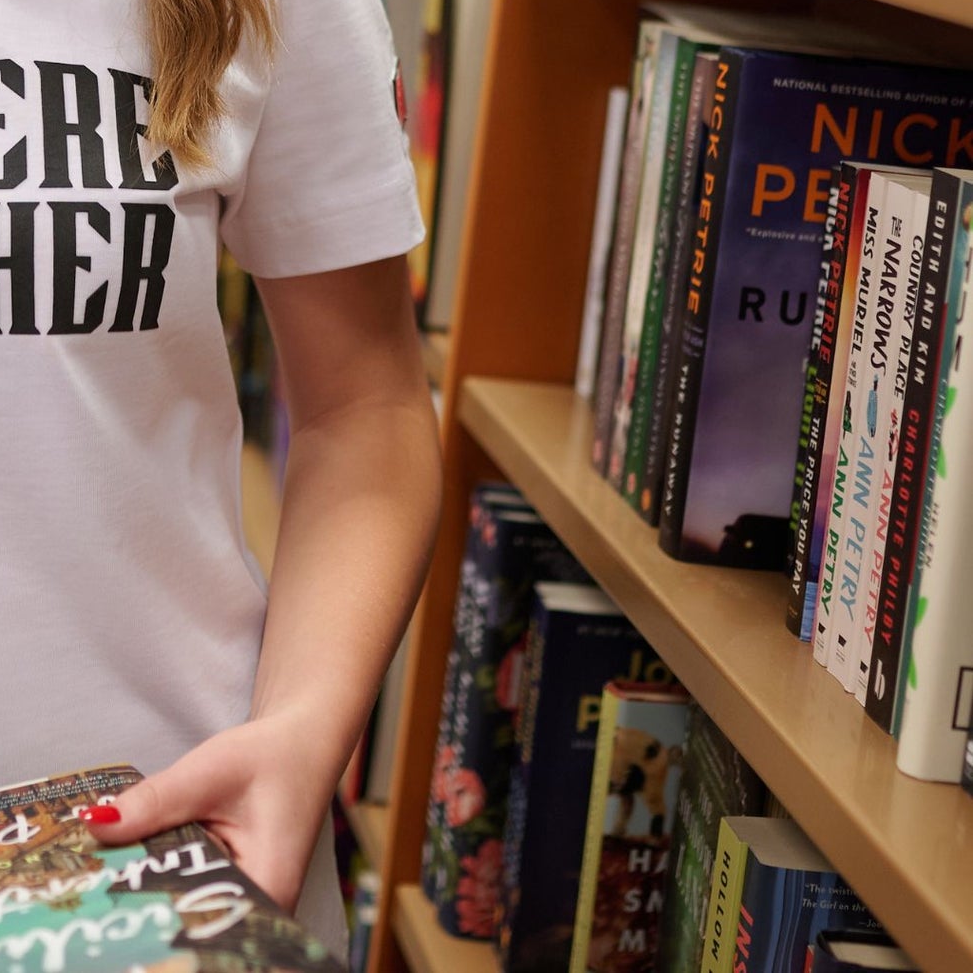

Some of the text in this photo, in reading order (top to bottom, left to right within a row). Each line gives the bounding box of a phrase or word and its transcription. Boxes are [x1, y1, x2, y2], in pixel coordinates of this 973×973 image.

[707, 62, 729, 159] NICK
[773, 78, 827, 93] NATIONAL
[831, 84, 900, 101] BESTSELLING
[905, 92, 948, 105] AUTHOR
[811, 103, 973, 167] NICK
[687, 172, 716, 315] PETRIE
[831, 181, 851, 252] NICK
[863, 207, 879, 259] MISS
[738, 286, 807, 326] RU
[819, 259, 842, 364] PETRIE
[851, 266, 872, 356] MURIEL
[870, 238, 902, 377] NARROWS
[893, 235, 924, 401] COUNTRY PLACE
[913, 200, 949, 387] EDITH AND KIM
[808, 417, 821, 451] THE
[801, 459, 816, 513] PRICE
[820, 445, 849, 616] ANN PETRY
[839, 436, 875, 622] ANN PETRY
[881, 408, 920, 646] CHARLOTTE PHILBY
[791, 562, 803, 596] PAY
[796, 518, 808, 555] YOU
[864, 469, 893, 645] ANN PETRY
[711, 850, 731, 961] HOLLOW
[820, 899, 837, 909] Girl
[839, 903, 850, 911] on
